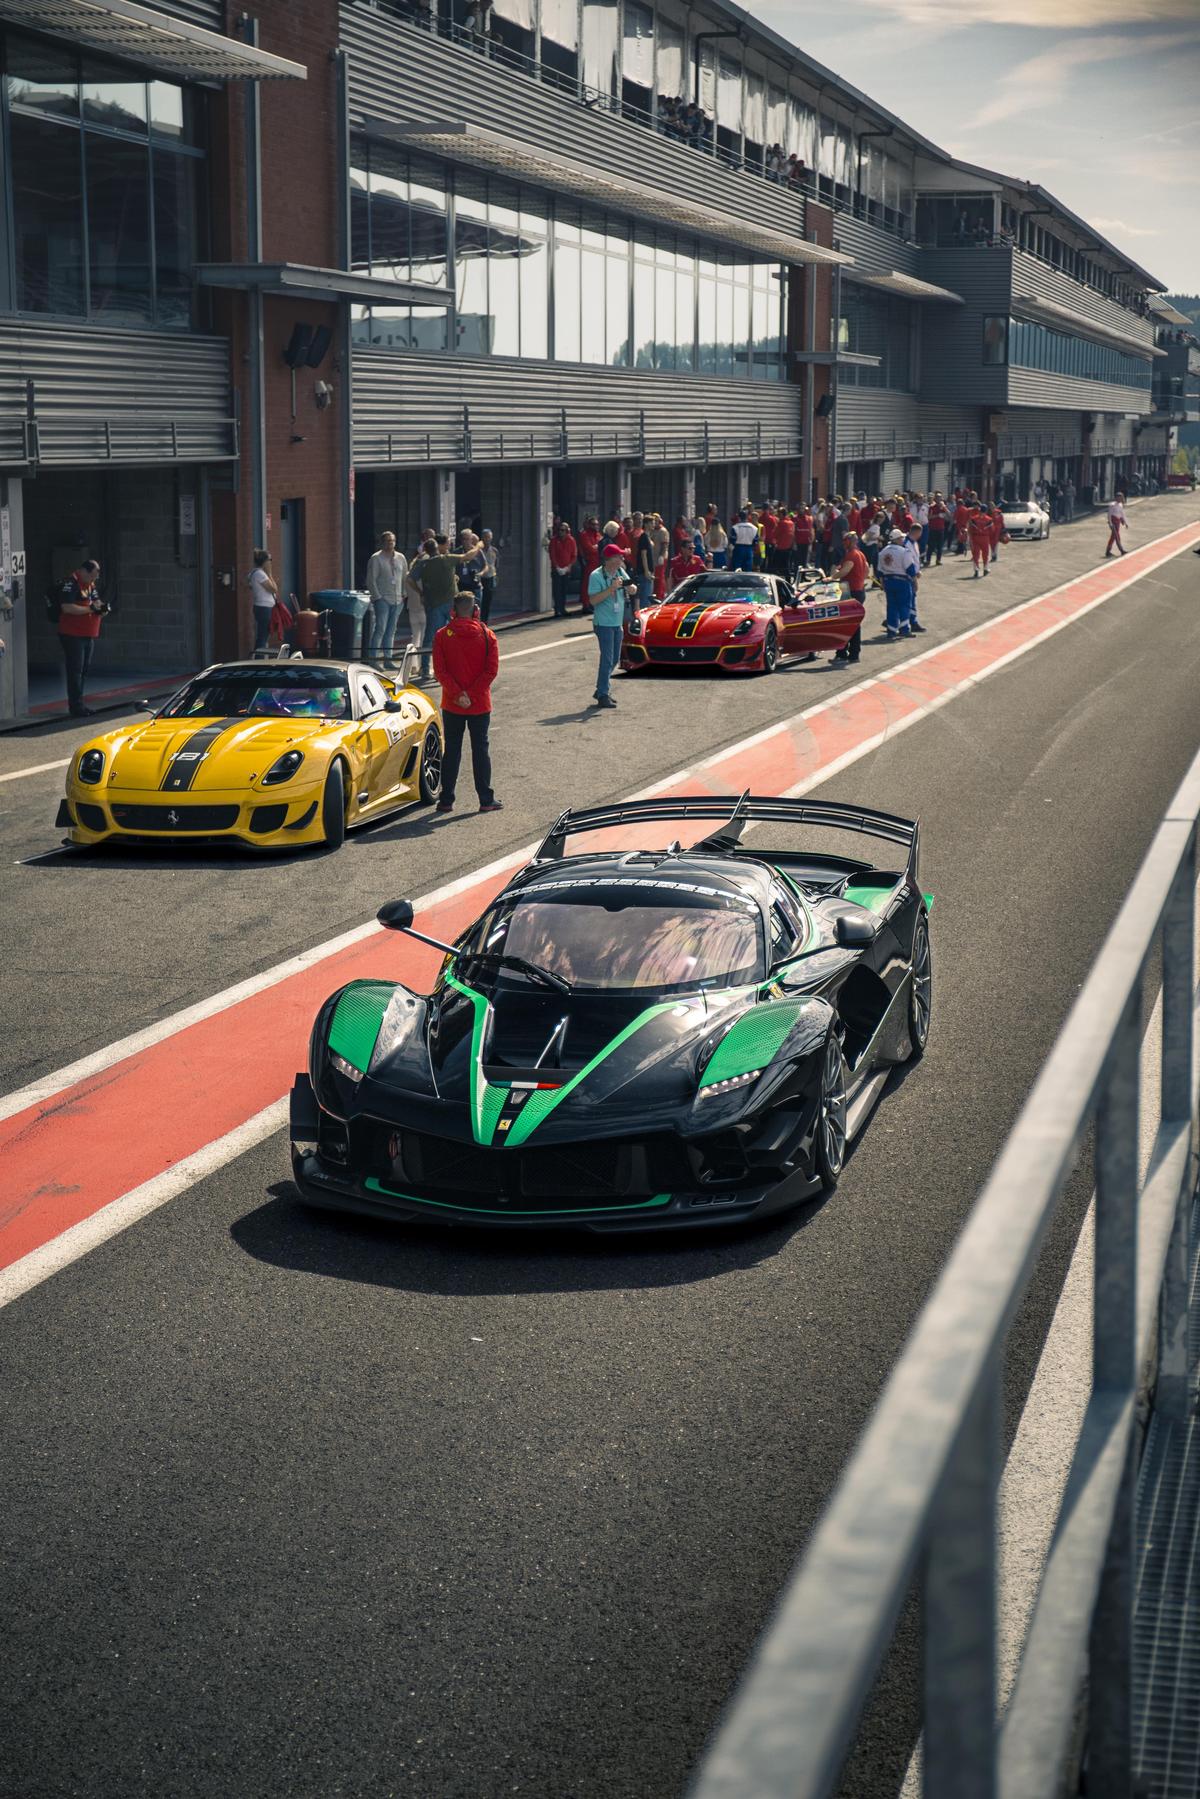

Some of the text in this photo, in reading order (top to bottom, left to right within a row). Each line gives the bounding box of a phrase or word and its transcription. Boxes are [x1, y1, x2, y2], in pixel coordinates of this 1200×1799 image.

[12, 555, 24, 574] 34
[807, 605, 839, 621] 132
[169, 752, 210, 761] 181
